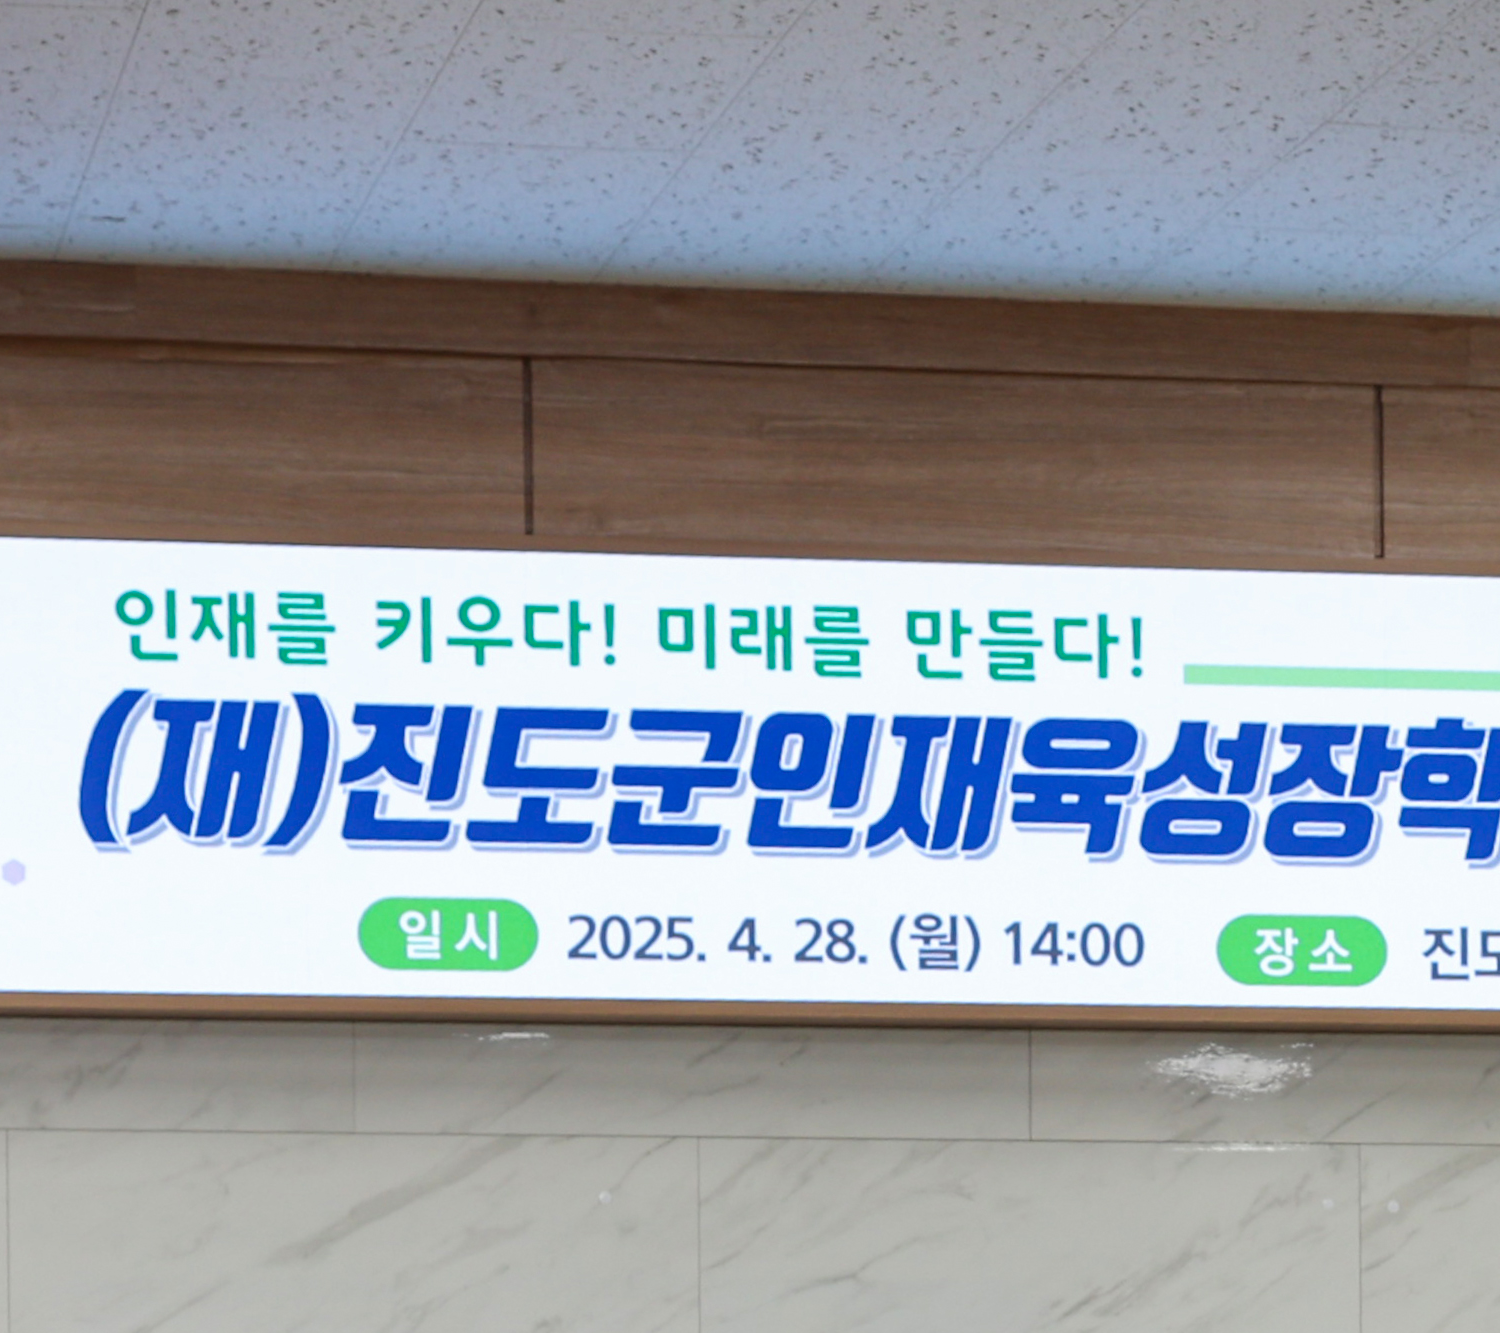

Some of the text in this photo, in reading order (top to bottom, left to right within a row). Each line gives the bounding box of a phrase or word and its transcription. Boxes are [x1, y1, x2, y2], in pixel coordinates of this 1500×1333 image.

[114, 588, 1143, 683] 인재를 키우다! 미래를 만들다!
[399, 910, 499, 960] 일시
[567, 912, 1146, 973] 2025. 4. 28. (월) 14:00
[1254, 927, 1354, 978] 장소
